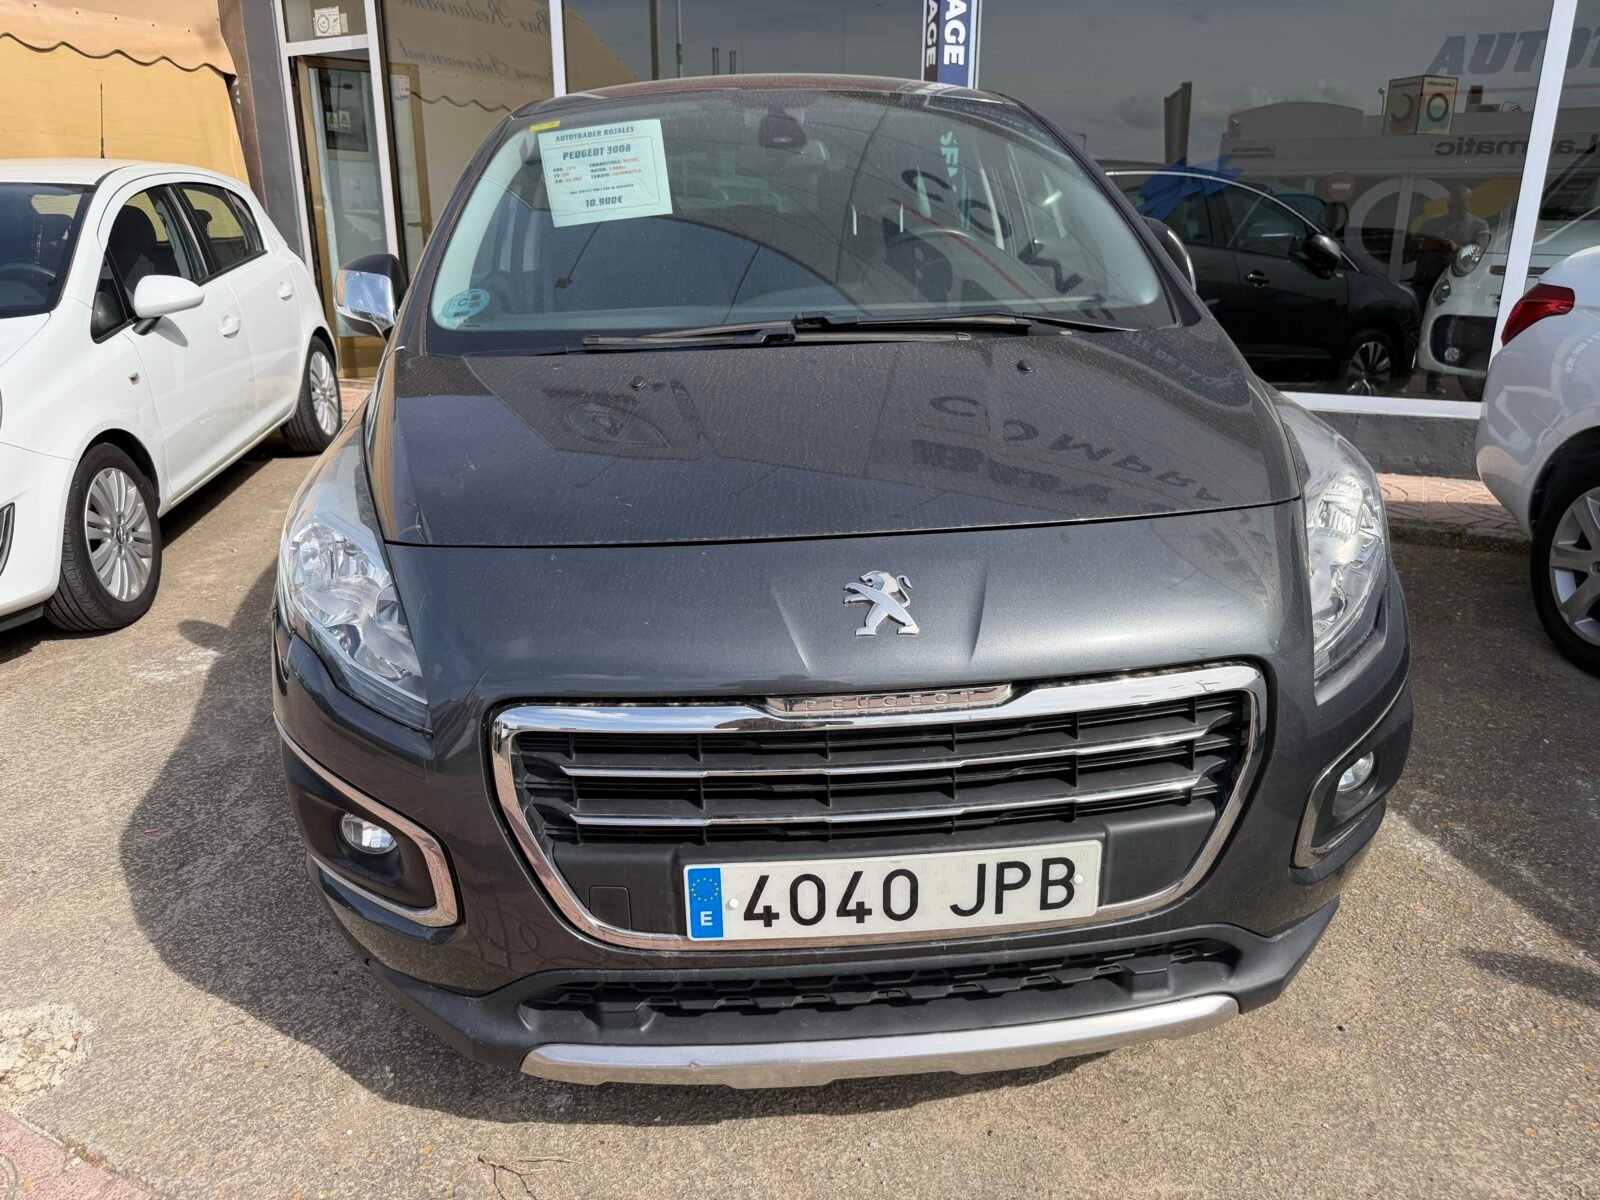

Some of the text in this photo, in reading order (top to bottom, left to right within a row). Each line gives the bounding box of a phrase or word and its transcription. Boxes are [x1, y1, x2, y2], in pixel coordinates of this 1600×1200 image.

[555, 130, 602, 142] AUTOTRADER
[562, 143, 631, 160] PEUGEOT 3008
[585, 195, 623, 208] 10.900€
[805, 690, 975, 711] PEUGEOT
[743, 856, 1076, 927] 4040 JPB
[700, 911, 713, 926] E
